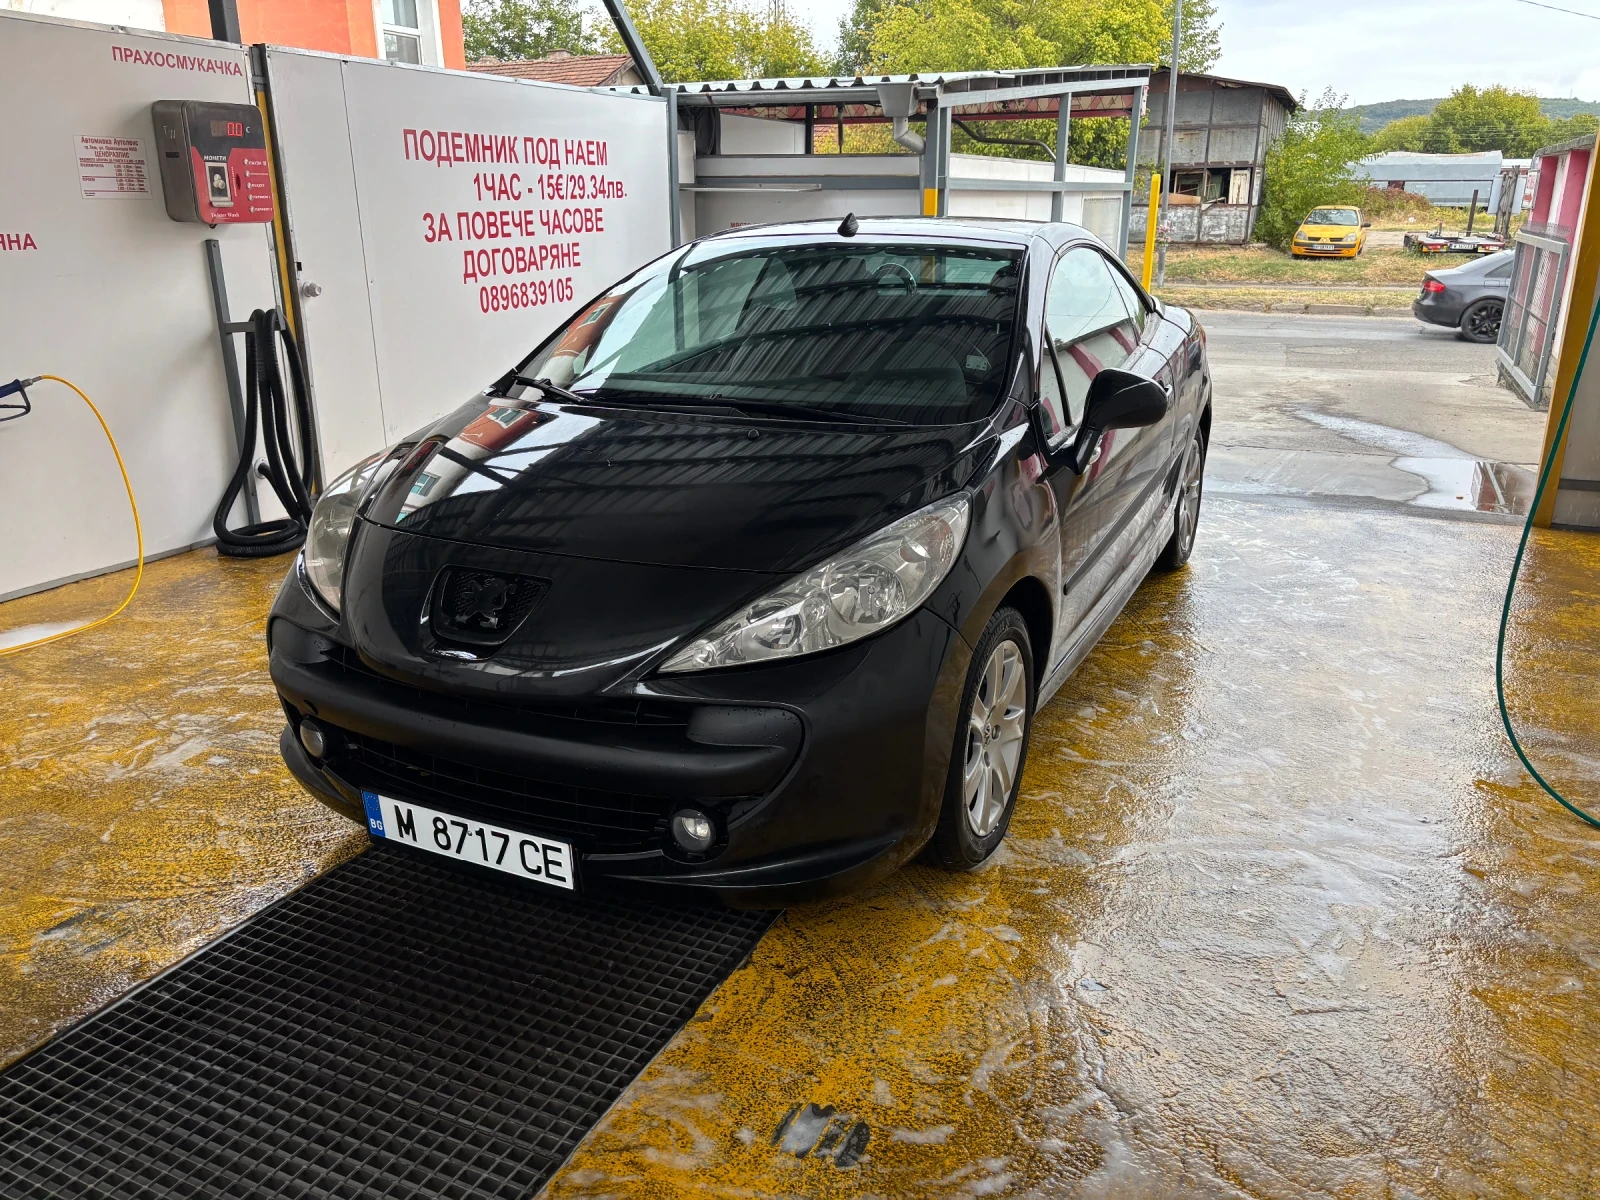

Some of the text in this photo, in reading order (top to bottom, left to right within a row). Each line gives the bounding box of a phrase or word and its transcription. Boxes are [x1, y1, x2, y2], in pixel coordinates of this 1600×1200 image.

[111, 46, 243, 77] ПРАХОСМУКАЧКА
[403, 128, 608, 170] ПОДЕМНИК ПОД НАЕМ
[473, 172, 522, 201] 1ЧАС
[537, 173, 628, 200] 15€/29.34лв.
[422, 207, 604, 243] ЗА ПОВЕЧЕ ЧАСОВЕ
[463, 242, 581, 284] ДОГОВАРЯНЕ
[479, 277, 574, 313] 0896839105
[369, 818, 383, 830] BG
[394, 804, 567, 883] M 8717 CE
